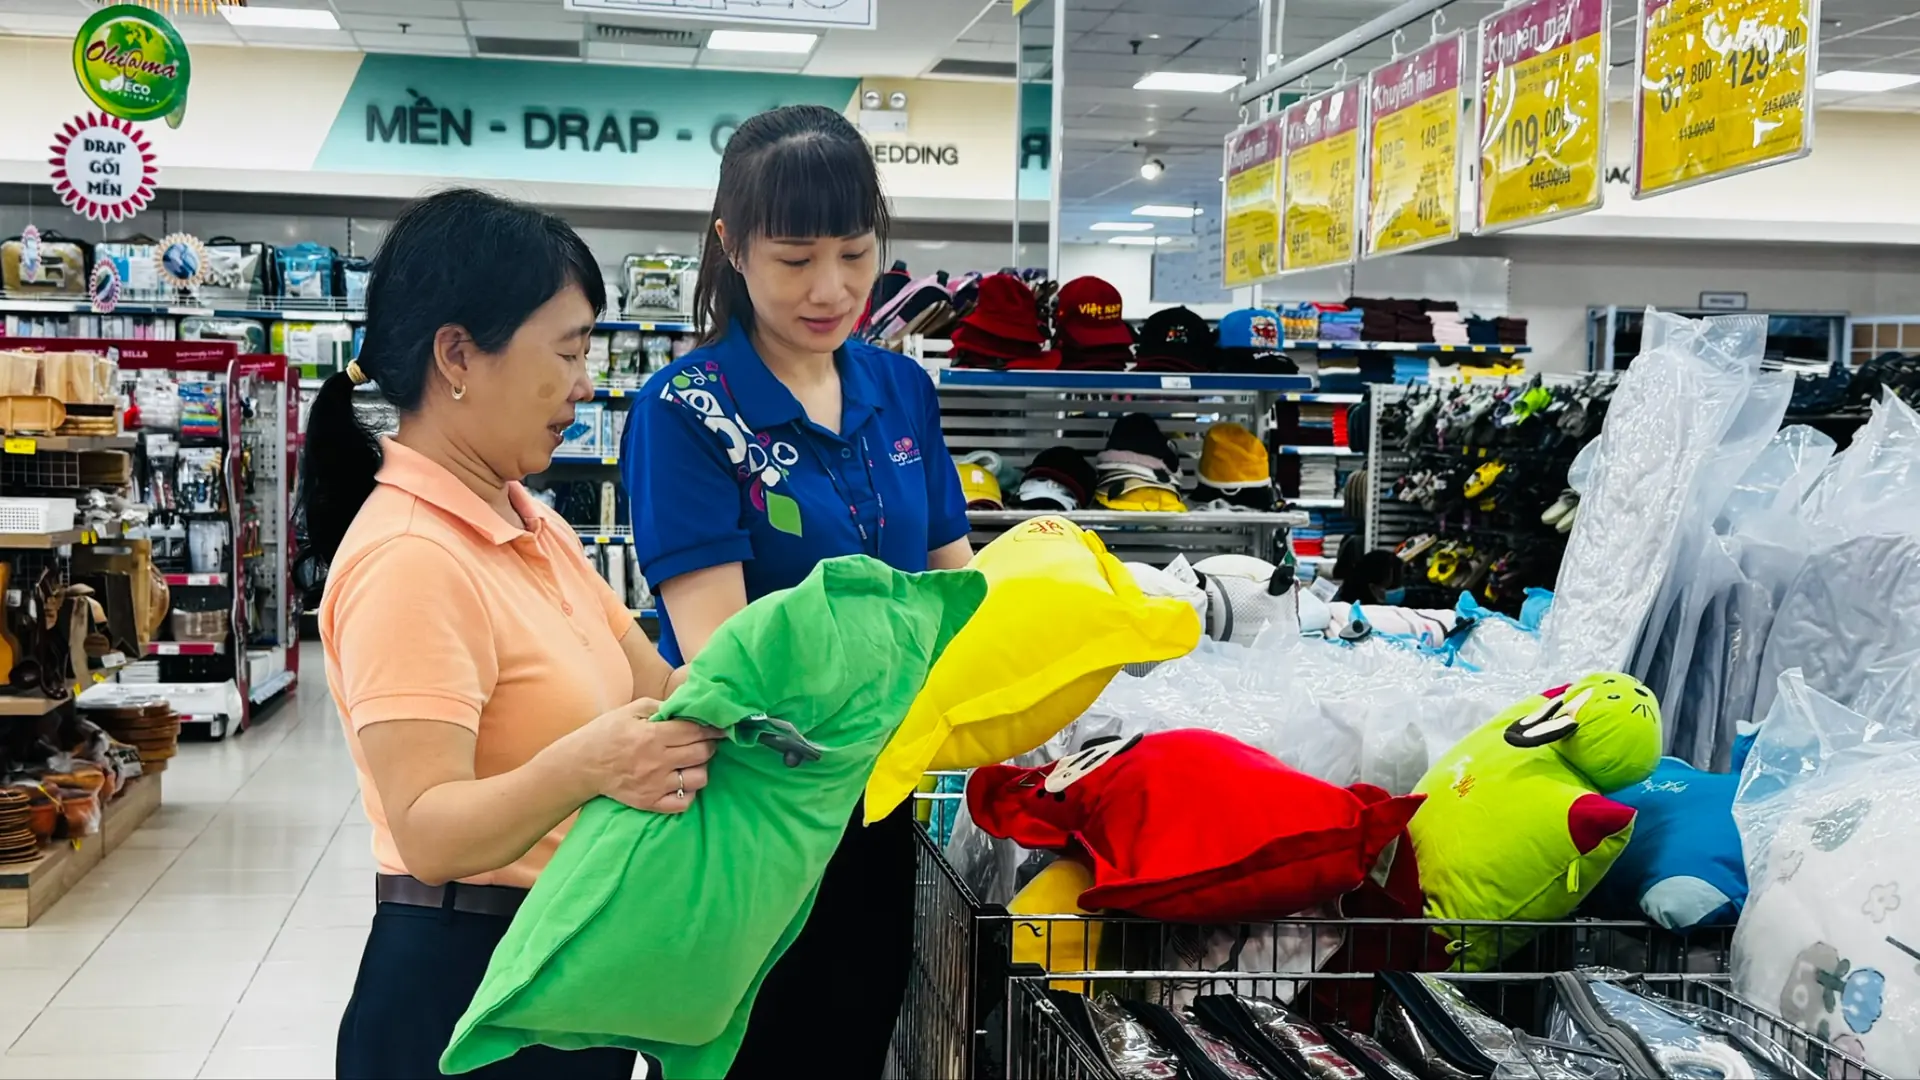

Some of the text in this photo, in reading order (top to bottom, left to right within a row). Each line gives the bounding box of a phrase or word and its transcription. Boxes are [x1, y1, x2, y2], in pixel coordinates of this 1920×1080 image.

[1728, 27, 1799, 89] 12900
[124, 82, 151, 95] ECO
[366, 88, 472, 146] MỀN
[523, 110, 660, 153] DRAP
[84, 138, 126, 154] DRAP
[89, 157, 120, 176] GỐI
[1078, 302, 1102, 318] Việt
